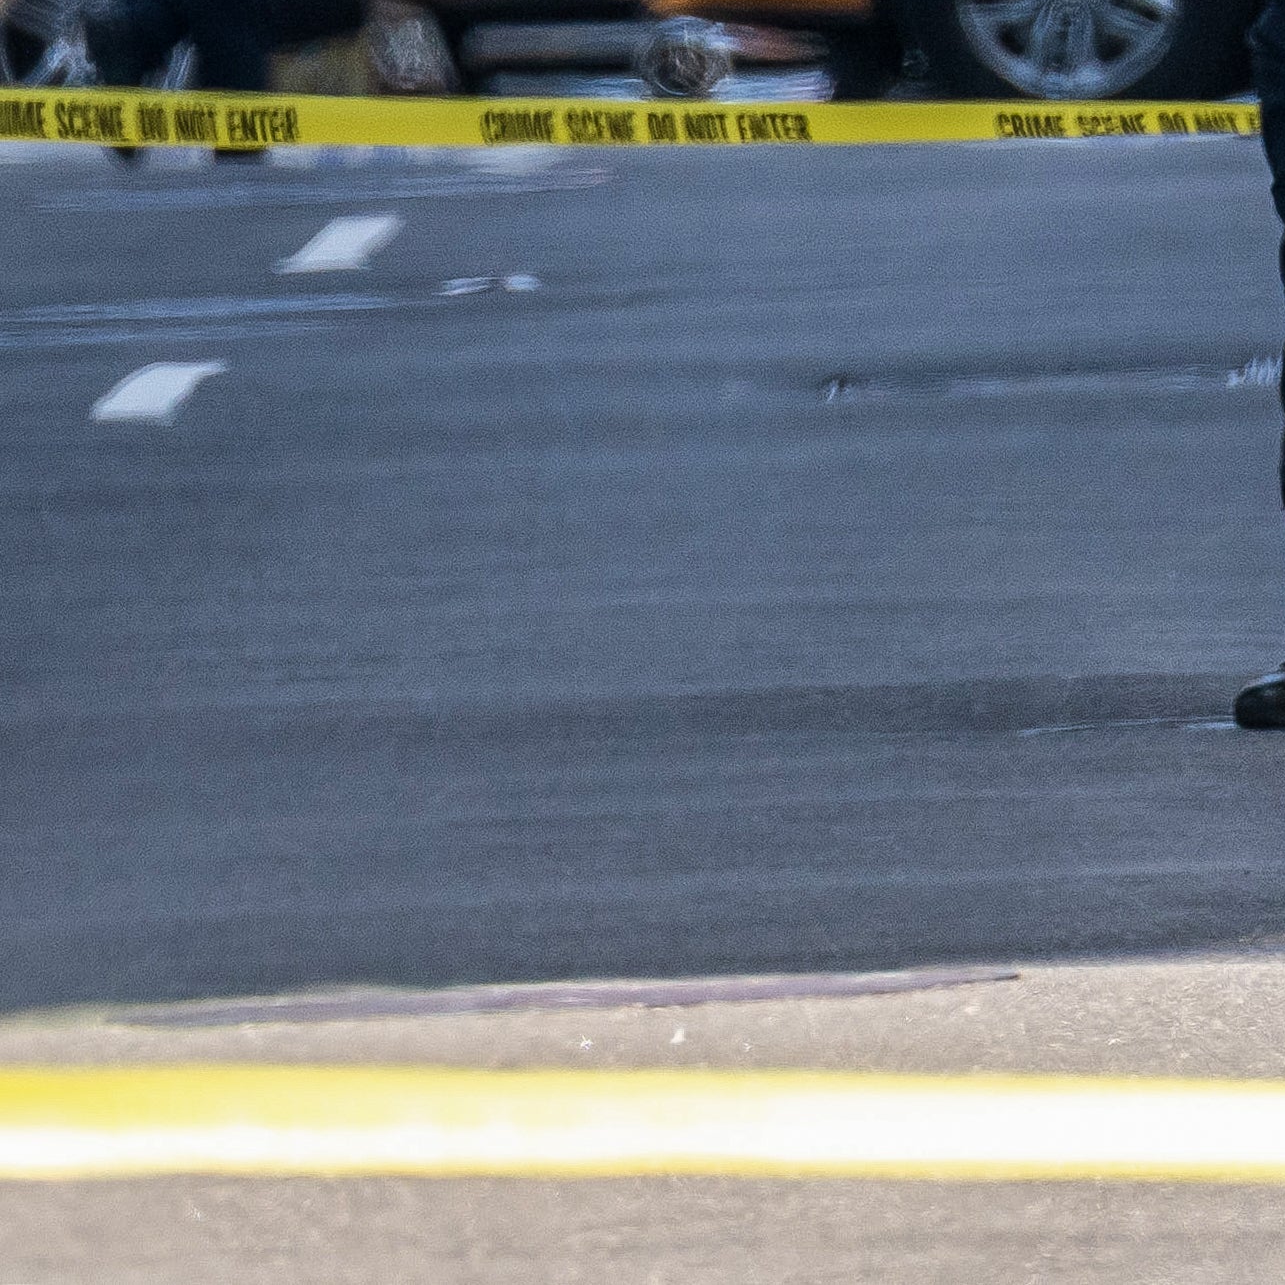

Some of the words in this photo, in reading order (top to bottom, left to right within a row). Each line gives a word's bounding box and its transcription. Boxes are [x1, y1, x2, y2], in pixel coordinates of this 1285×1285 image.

[54, 99, 123, 140] SCENE
[225, 105, 298, 144] ENTER
[565, 108, 635, 143] SCENE
[647, 111, 678, 142] DO
[683, 111, 728, 143] NOT
[737, 111, 813, 143] ENTER
[992, 111, 1067, 138] CRIME
